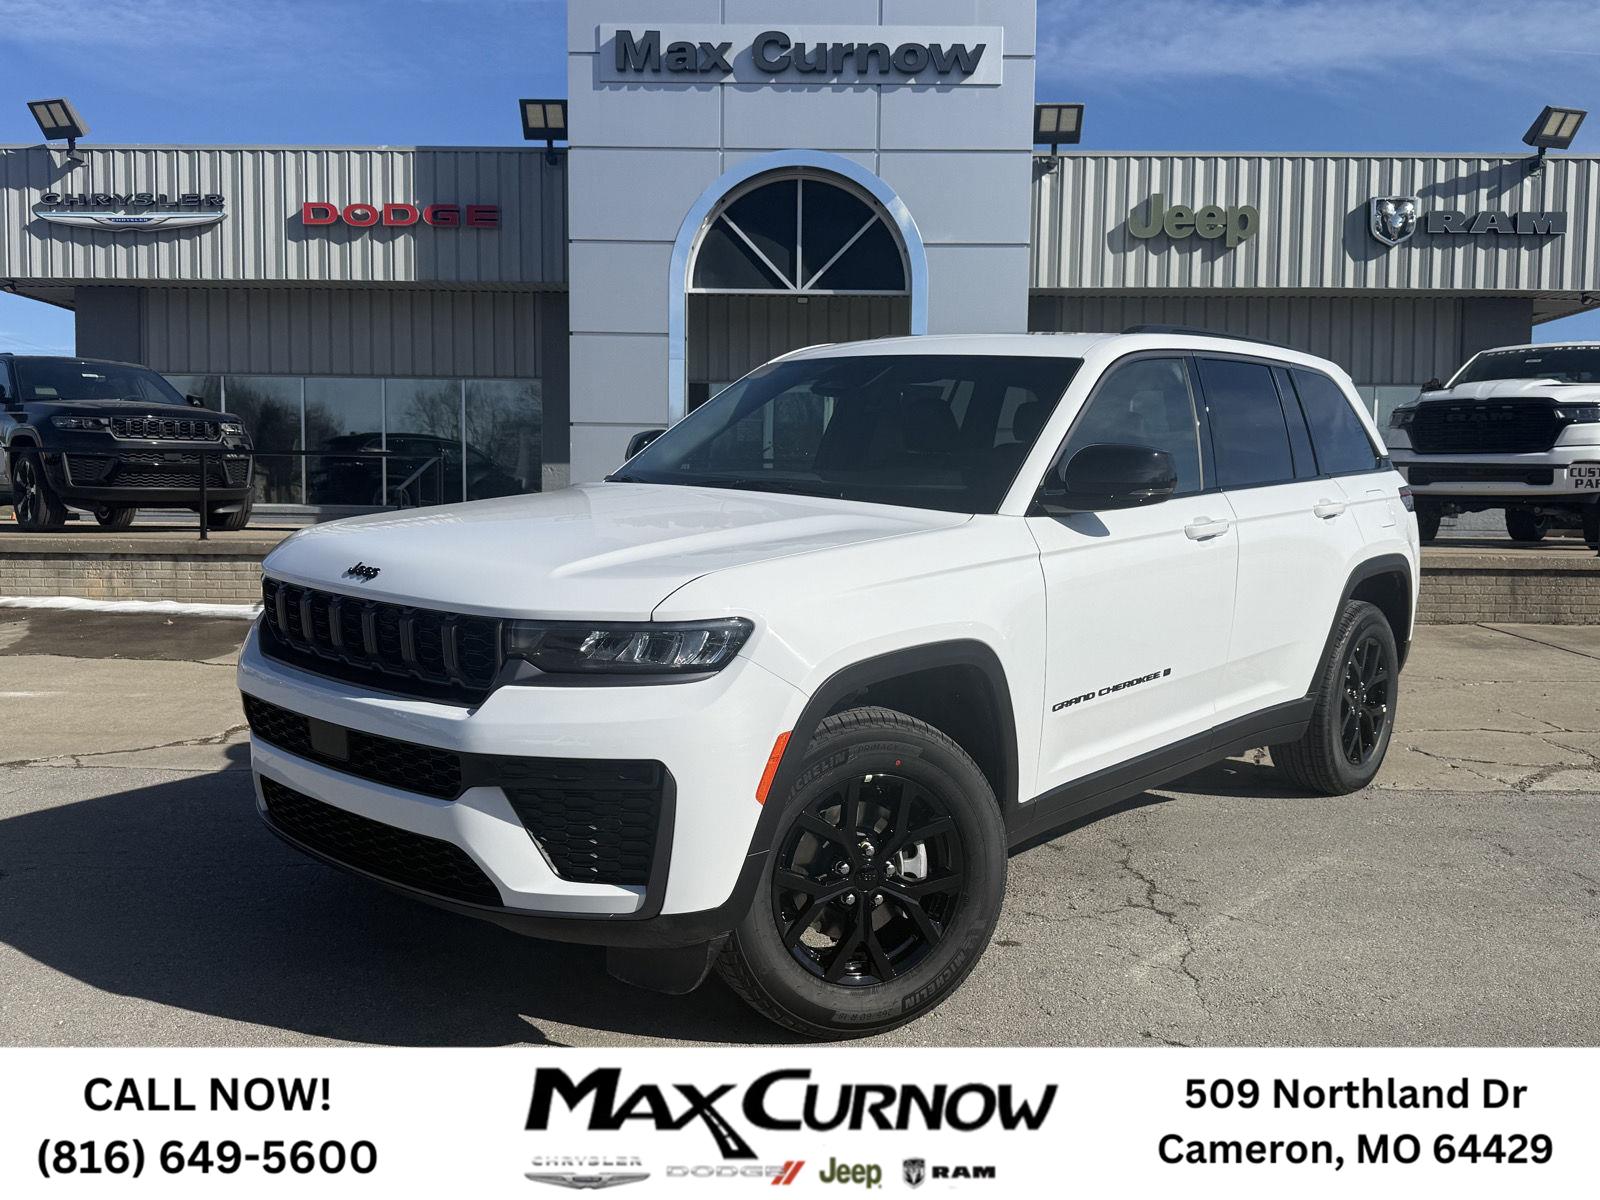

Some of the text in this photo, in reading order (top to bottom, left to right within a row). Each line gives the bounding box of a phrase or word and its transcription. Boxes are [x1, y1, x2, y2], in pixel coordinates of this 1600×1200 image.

[615, 30, 987, 75] Max Curnow
[40, 192, 225, 207] CHRYSLER
[303, 202, 498, 228] DODGE
[1128, 193, 1260, 248] Jeep
[1428, 210, 1567, 234] RAM
[1052, 671, 1161, 712] GRAND CHEROKEE
